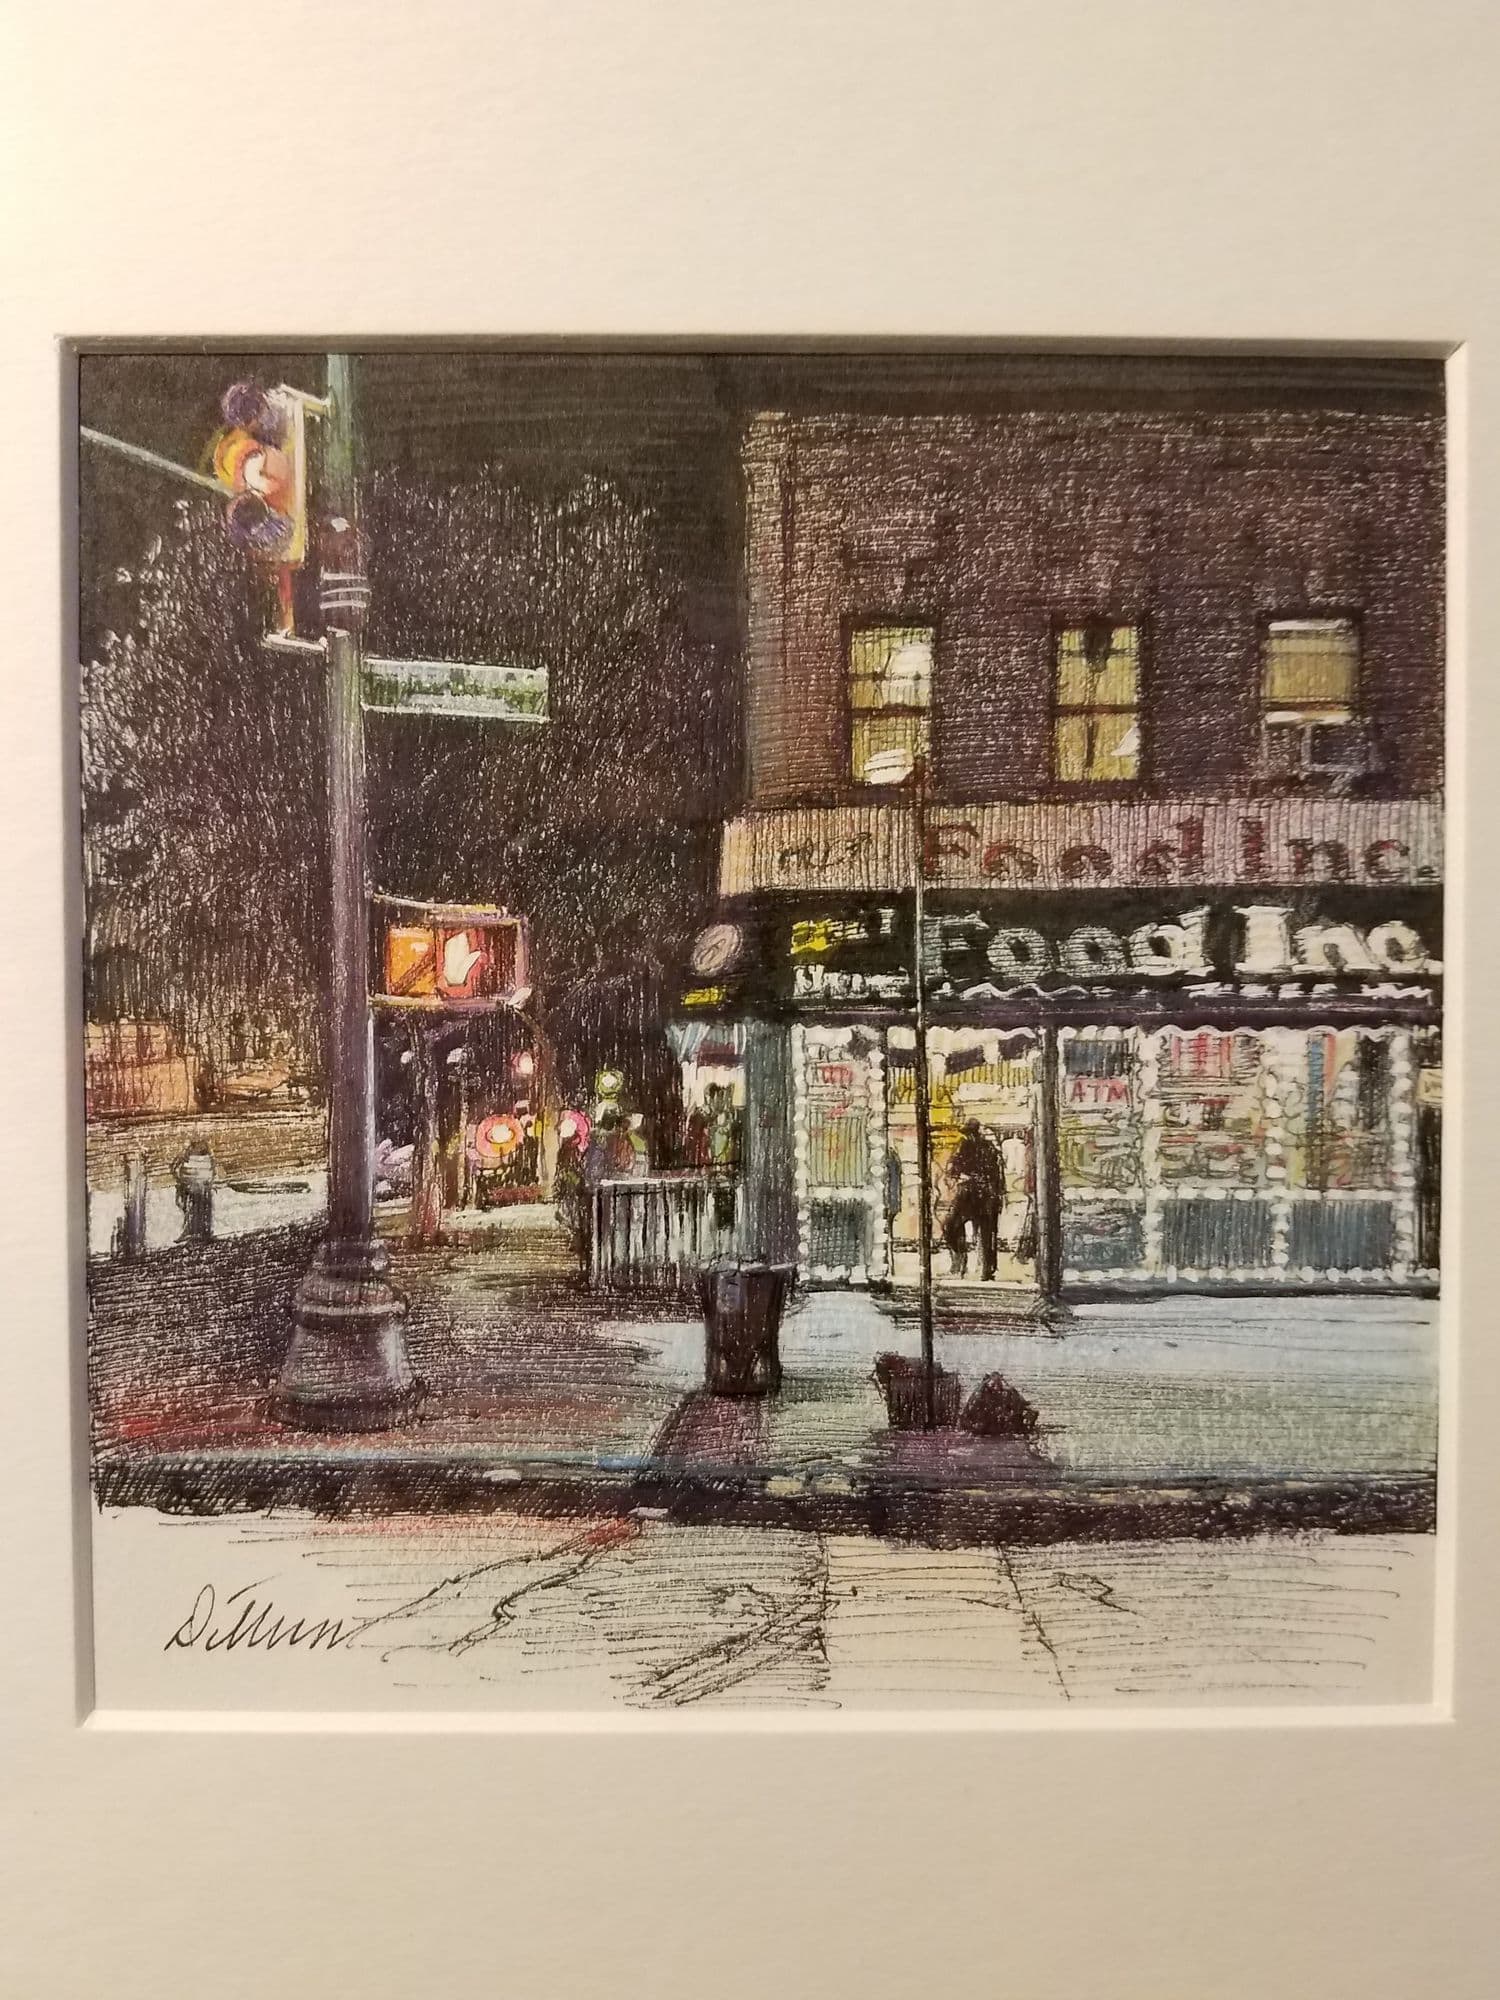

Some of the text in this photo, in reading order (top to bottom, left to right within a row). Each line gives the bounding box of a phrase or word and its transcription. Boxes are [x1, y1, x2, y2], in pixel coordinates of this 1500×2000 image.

[921, 816, 1204, 878] Food
[922, 907, 1216, 980] Food
[1069, 1081, 1130, 1104] ATM
